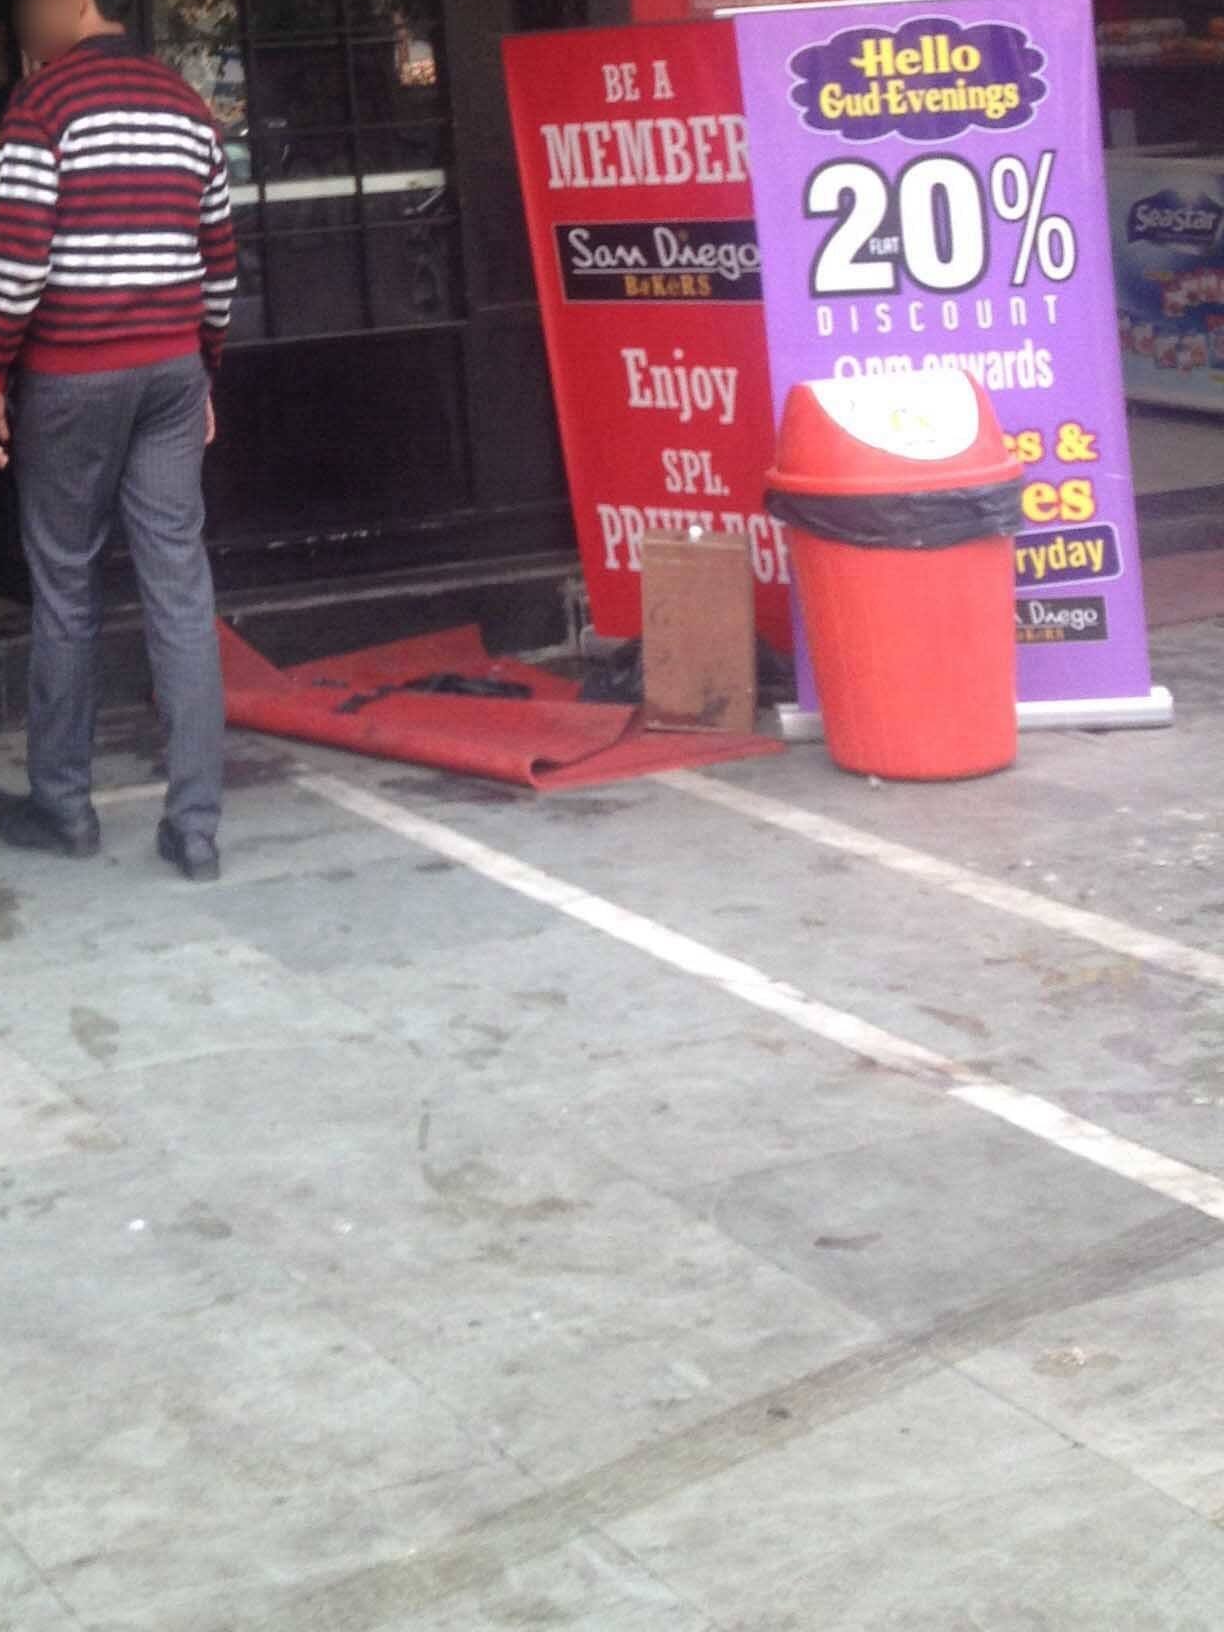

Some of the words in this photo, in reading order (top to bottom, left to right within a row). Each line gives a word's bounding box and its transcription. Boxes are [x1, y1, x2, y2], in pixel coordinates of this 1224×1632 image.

[850, 34, 981, 78] Hello
[602, 62, 640, 104] BE
[652, 59, 674, 100] A
[819, 81, 881, 119] Gud
[880, 77, 1019, 119] Evenings
[540, 113, 750, 190] MEMBER
[806, 151, 1077, 297] 20%
[568, 228, 648, 268] San
[653, 226, 759, 281] Diego
[816, 294, 1058, 336] DISCOUNT
[621, 347, 739, 424] Enjoy
[661, 447, 731, 497] SPL.
[1015, 536, 1105, 579] ryday
[1028, 600, 1099, 630] Diego
